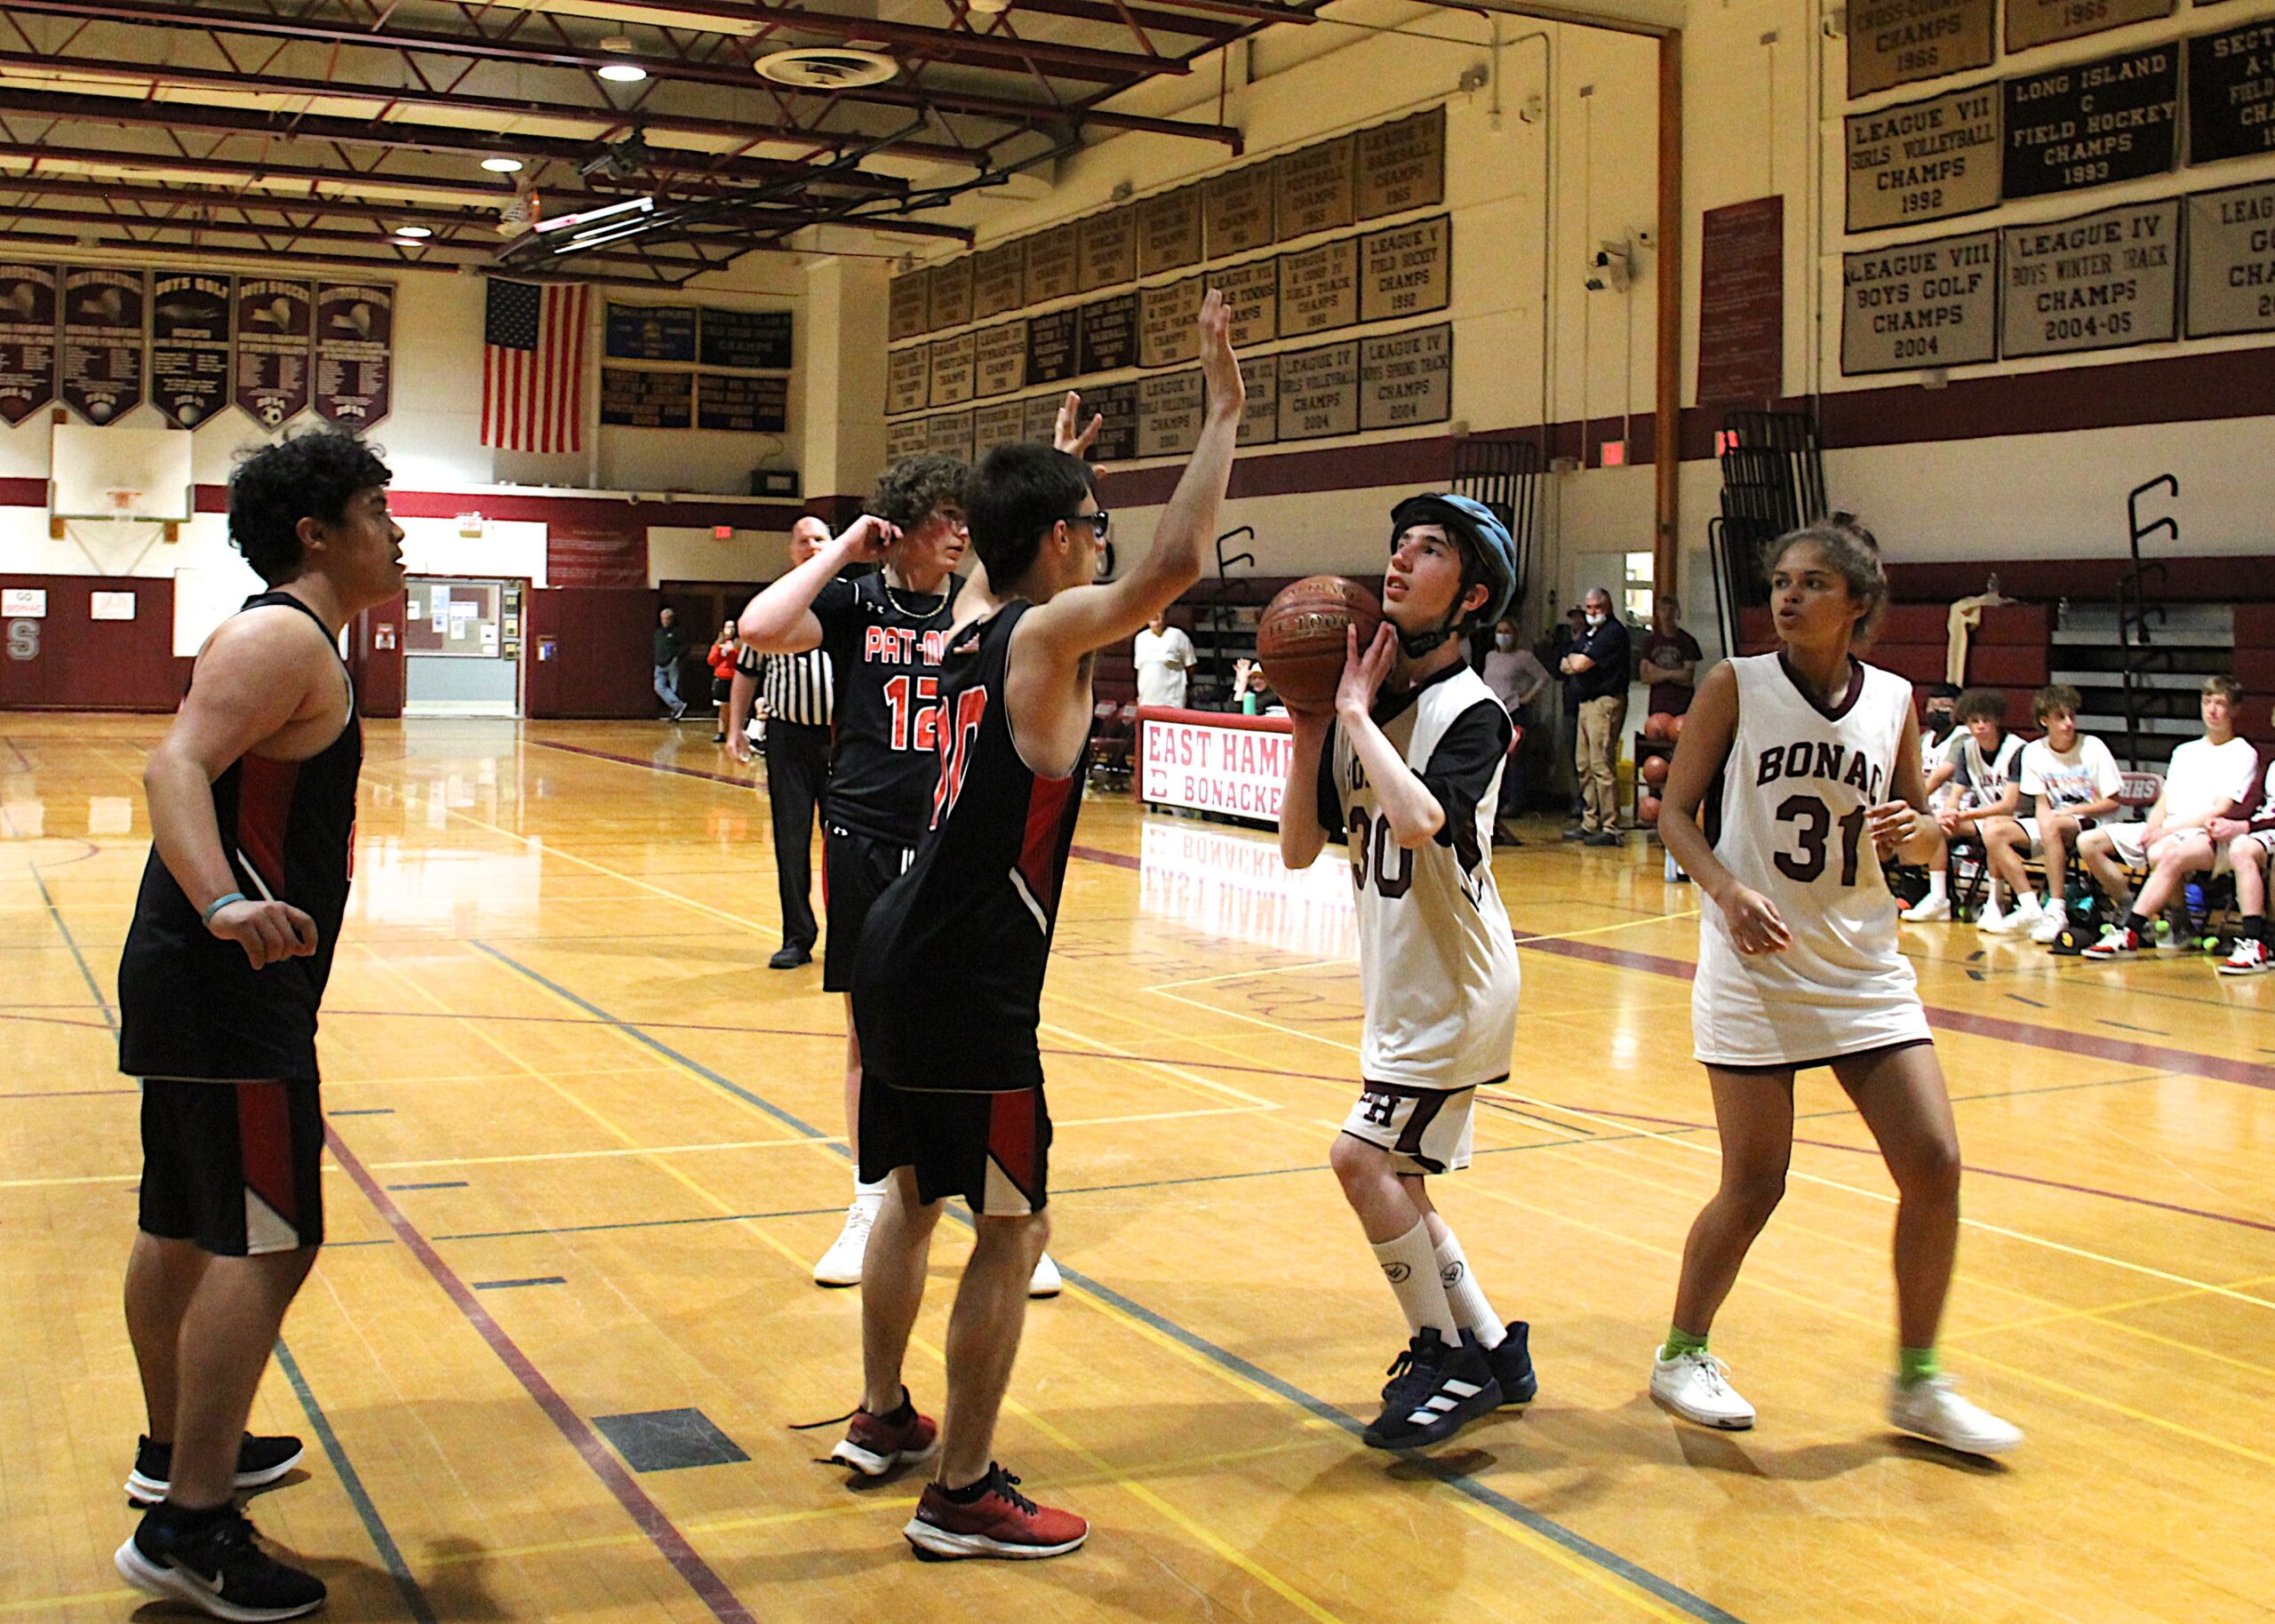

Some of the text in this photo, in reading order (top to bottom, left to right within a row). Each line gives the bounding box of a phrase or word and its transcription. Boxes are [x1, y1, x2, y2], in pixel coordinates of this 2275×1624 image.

[1877, 12, 1961, 53] CHAMPS
[2016, 54, 2167, 101] LONG ISLAND
[1855, 96, 1989, 144] LEAGUE VII
[2014, 100, 2176, 147] FIELD HOCKEY
[1850, 123, 1995, 171] GIRLS VOLLEYBALL
[2045, 133, 2133, 165] CHAMPS
[1877, 156, 1966, 190] CHAMPS
[2064, 162, 2110, 185] 1993
[1902, 187, 1944, 213] 1992
[1370, 230, 1422, 255] LEAGUE
[2018, 215, 2160, 257] LEAGUE IV
[1849, 243, 1990, 283] LEAGUE VIII
[2012, 244, 2167, 286] BOYS WINTER TRACK
[1379, 268, 1430, 292] CHAMPS
[1856, 273, 1983, 308] BOYS GOLF
[2036, 279, 2137, 313] CHAMPS
[1297, 294, 1338, 314] CHAMPS
[1872, 305, 1963, 334] CHAMPS
[2258, 294, 2275, 316] 2
[2045, 311, 2133, 341] 2004-05
[1369, 334, 1441, 360] LEAGUE IV
[1894, 335, 1938, 359] 2004
[1285, 354, 1332, 375] LEAGUE
[1147, 379, 1185, 397] LEAGUE
[1293, 392, 1340, 412] CHAMPS
[1377, 378, 1430, 401] CHAMPS
[1150, 414, 1190, 432] CHAMPS
[1149, 726, 1211, 768] EAST
[1185, 776, 1281, 816] BONACKE
[1350, 807, 1412, 898] 30
[1774, 795, 1865, 887] 31
